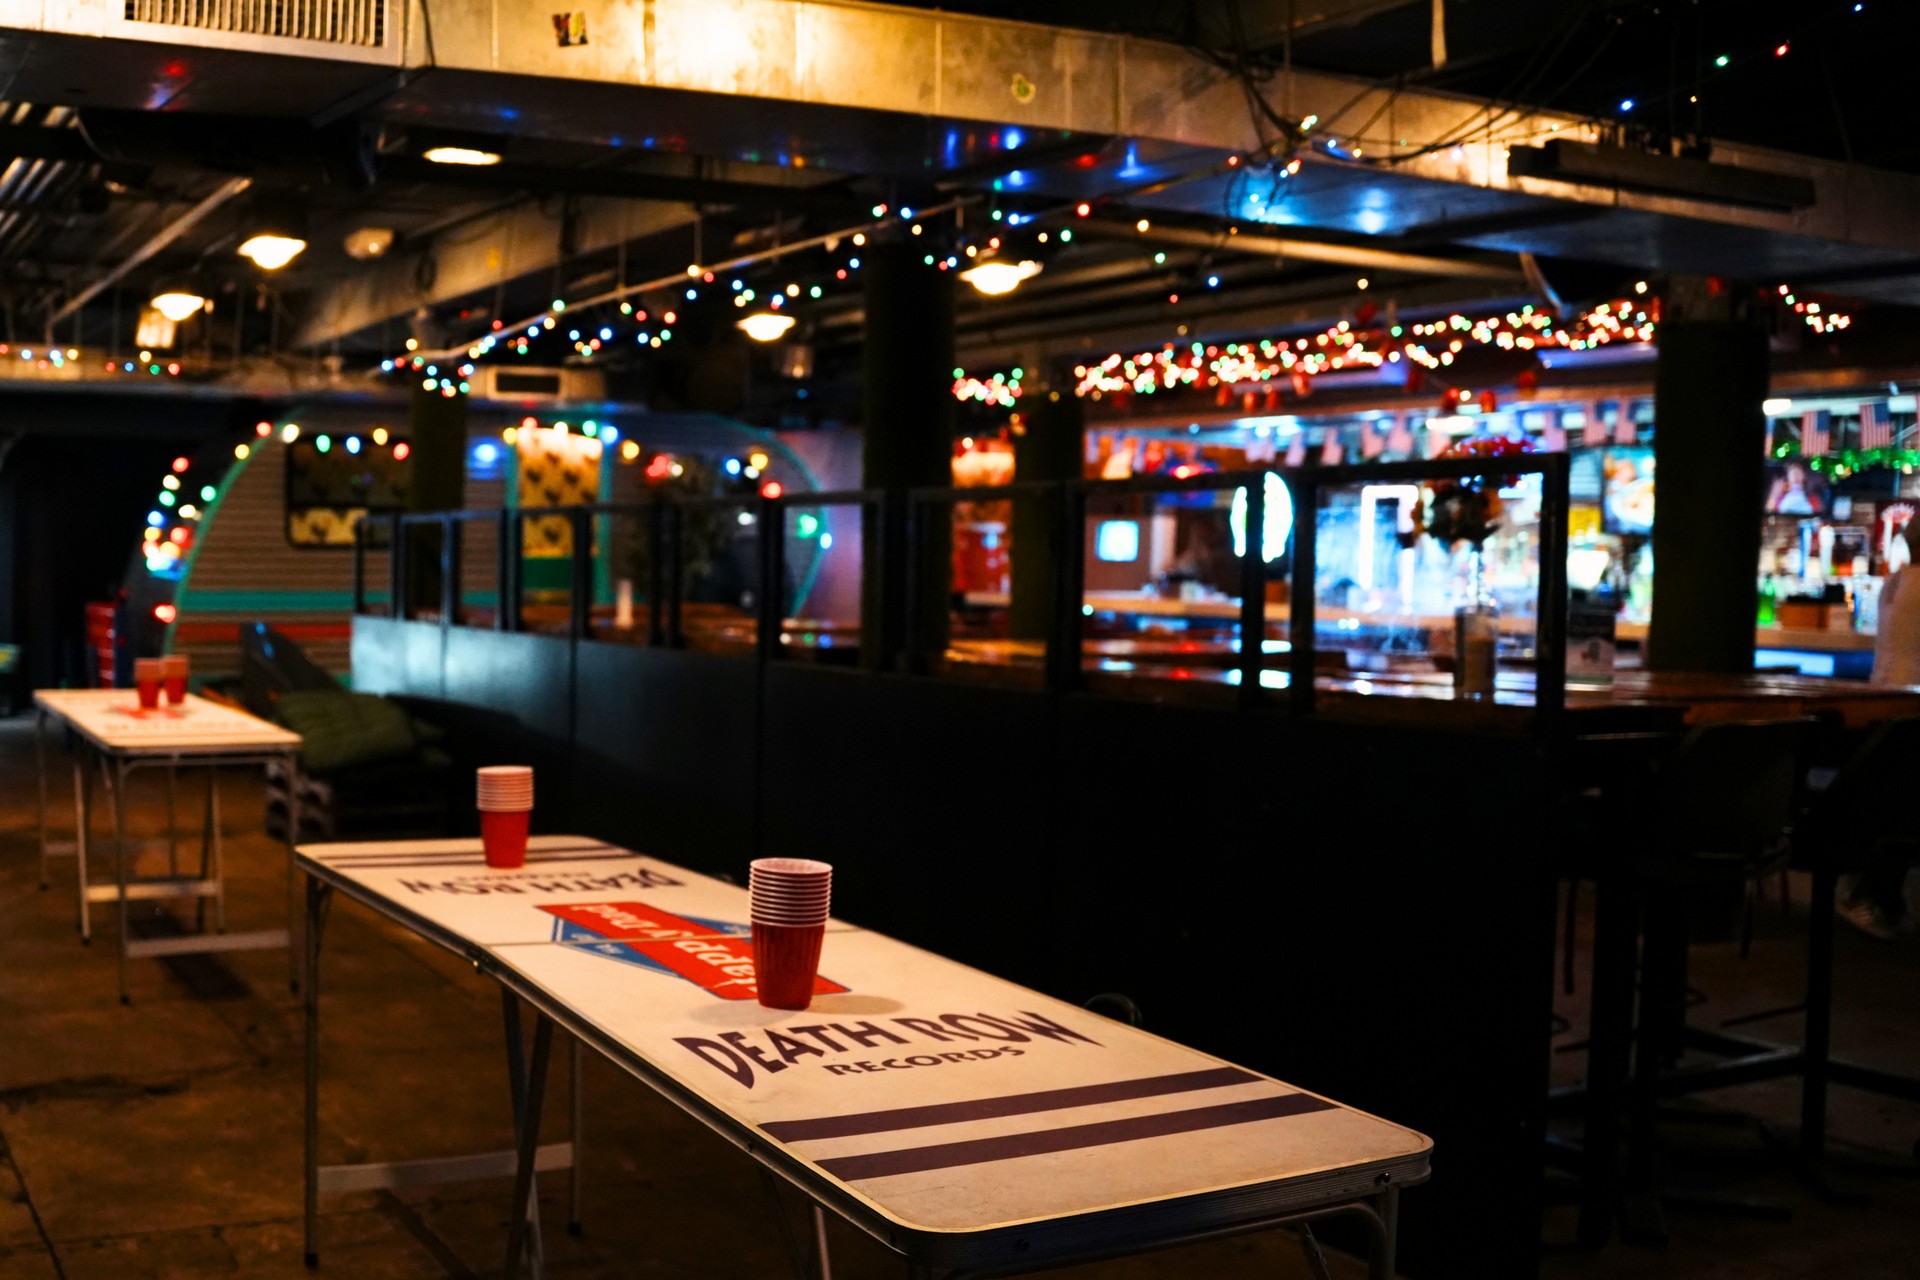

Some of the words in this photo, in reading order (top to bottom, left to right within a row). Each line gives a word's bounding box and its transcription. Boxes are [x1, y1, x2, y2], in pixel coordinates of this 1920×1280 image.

[397, 876, 526, 895] ROW
[528, 868, 687, 893] DEATH
[672, 1020, 911, 1089] DEATH
[892, 1010, 1106, 1047] ROW
[822, 1045, 1026, 1076] RECORDS
